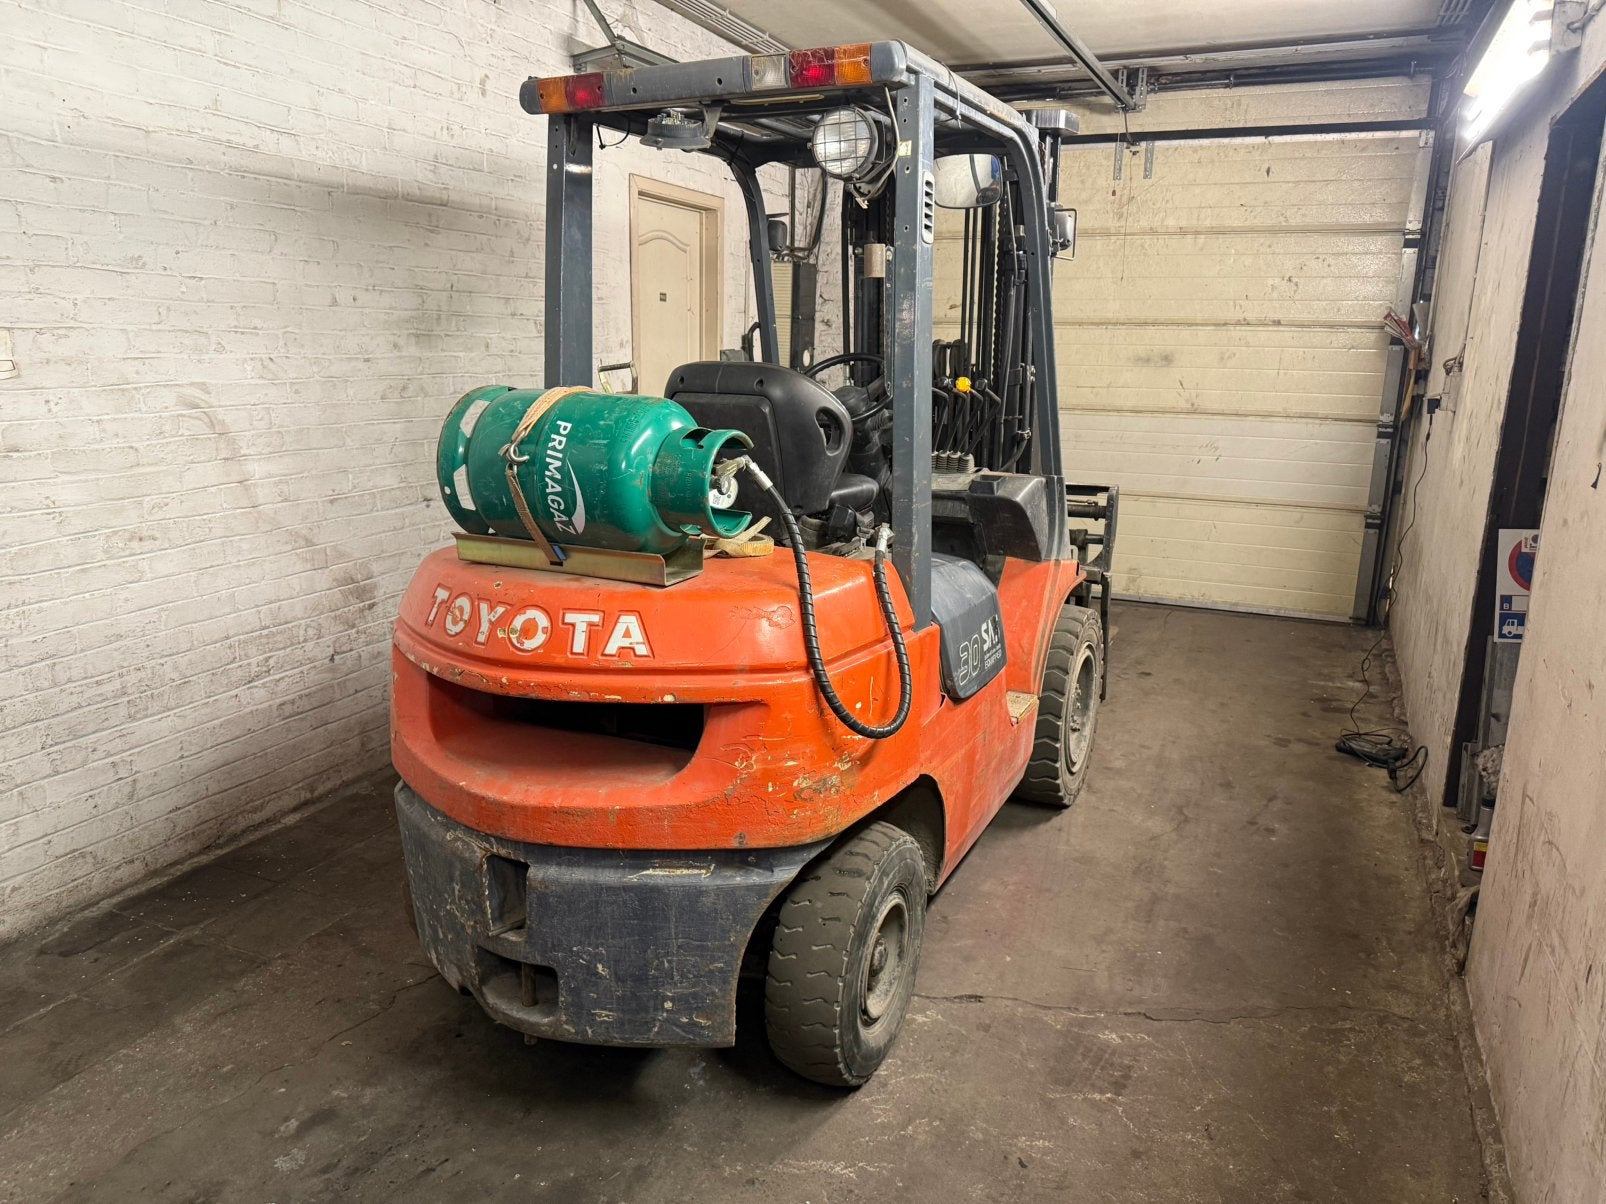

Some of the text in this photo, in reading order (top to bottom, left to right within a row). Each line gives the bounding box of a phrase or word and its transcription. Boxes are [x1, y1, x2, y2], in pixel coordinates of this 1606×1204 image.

[544, 420, 577, 535] PRIMAGAZ
[426, 585, 651, 656] TOYOTA
[959, 634, 981, 686] 30
